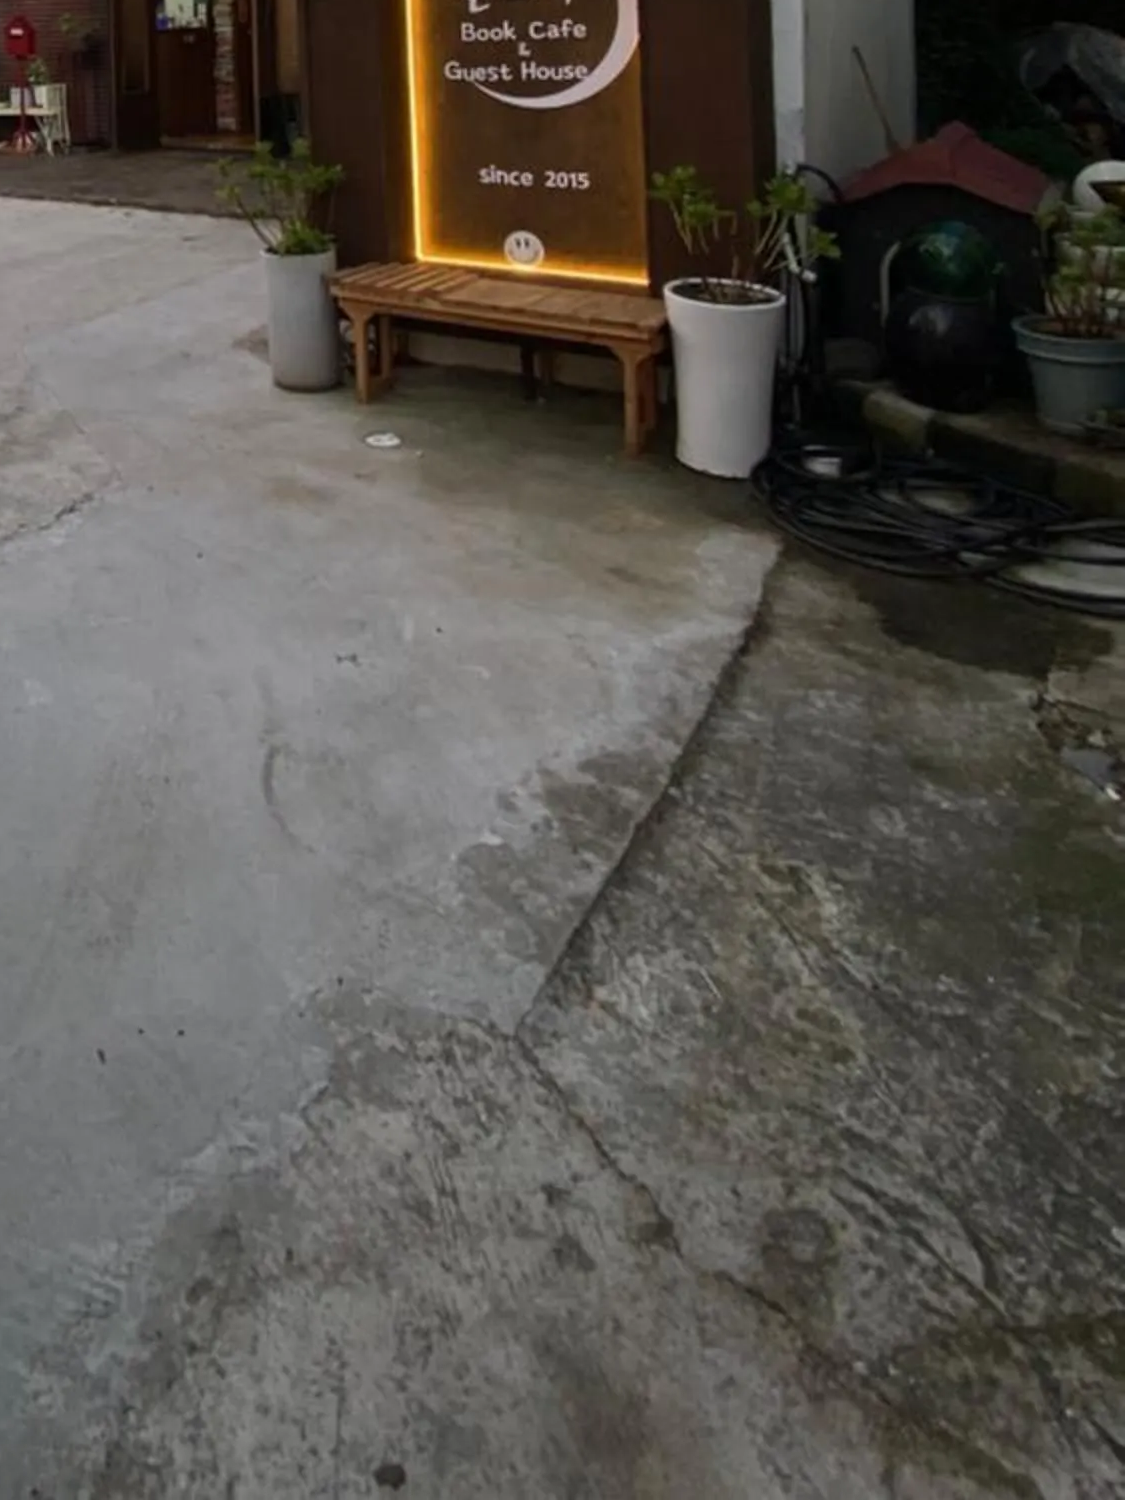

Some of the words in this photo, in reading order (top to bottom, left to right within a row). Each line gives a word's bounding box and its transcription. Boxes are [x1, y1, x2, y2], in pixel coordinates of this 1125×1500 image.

[461, 20, 517, 42] Book
[528, 18, 587, 39] Cafe
[443, 60, 513, 81] Guest
[520, 60, 589, 81] House
[479, 164, 534, 187] since
[544, 170, 591, 190] 2015
